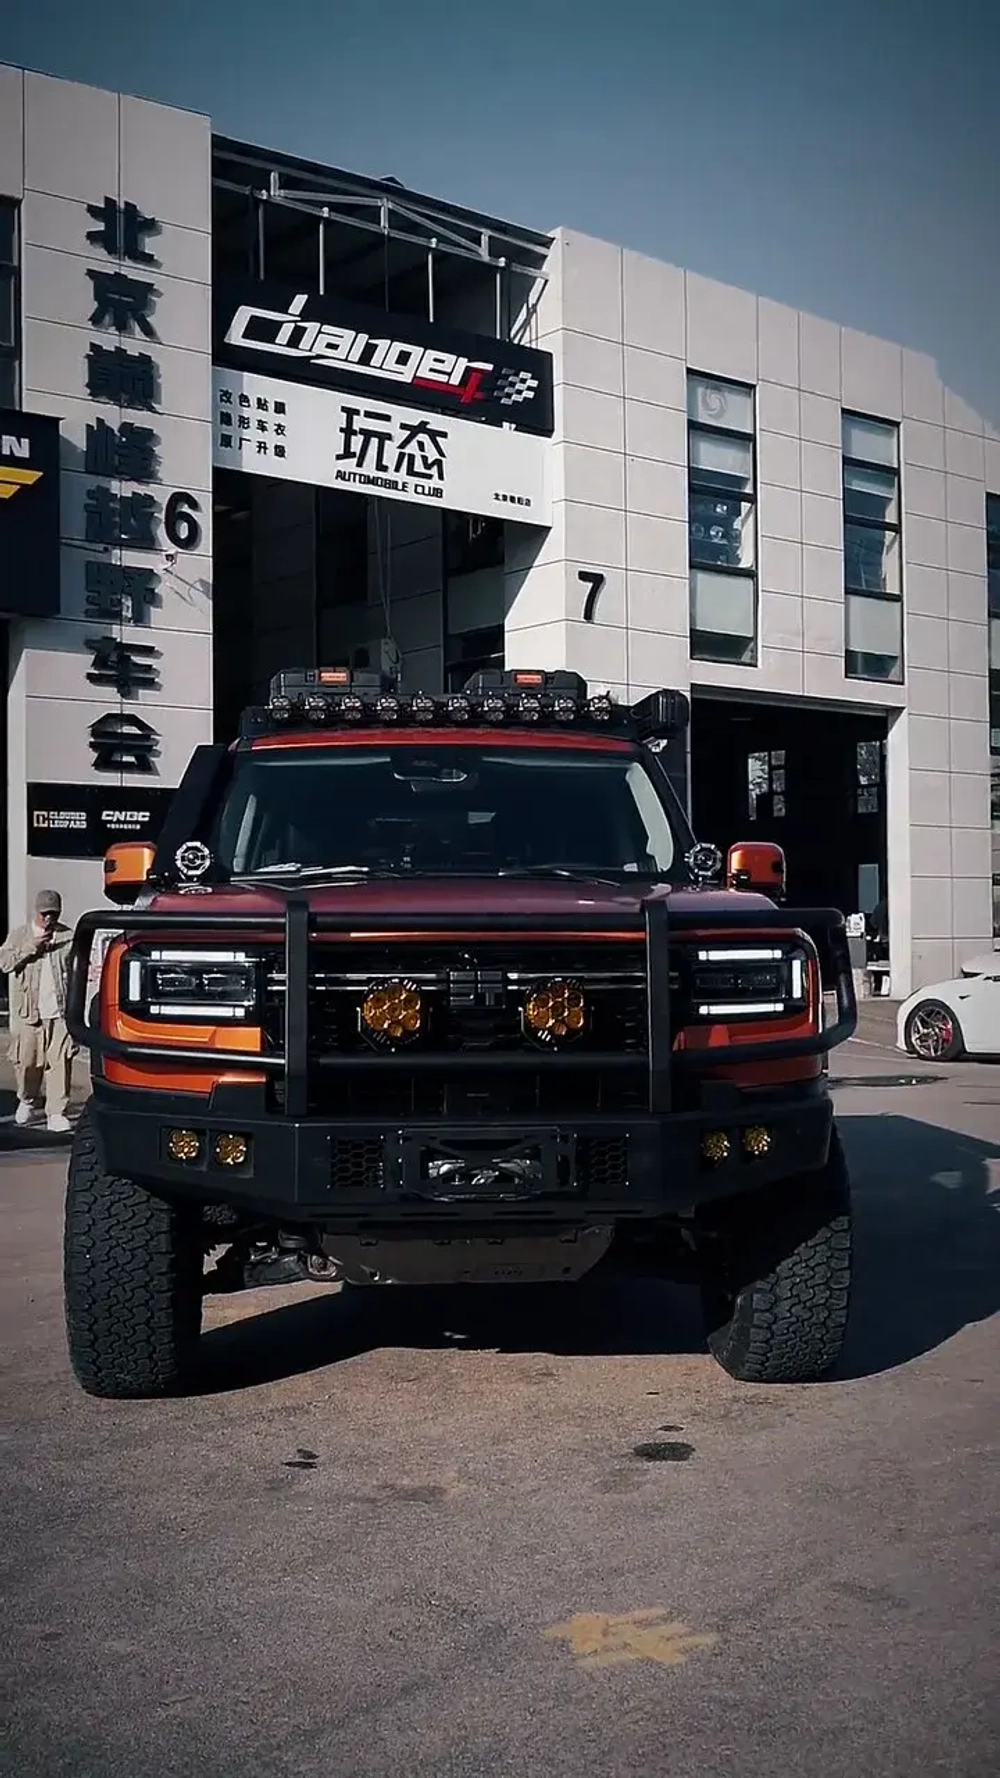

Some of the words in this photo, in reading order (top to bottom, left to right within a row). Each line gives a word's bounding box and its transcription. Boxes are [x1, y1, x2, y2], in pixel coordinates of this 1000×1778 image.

[219, 411, 287, 437] 隐形车衣
[335, 405, 448, 481] 玩态
[219, 433, 287, 459] 原厂升级
[335, 469, 409, 493] AUTOMOBILE
[414, 483, 443, 499] CLUB
[164, 491, 202, 550] 6
[577, 570, 606, 623] 7
